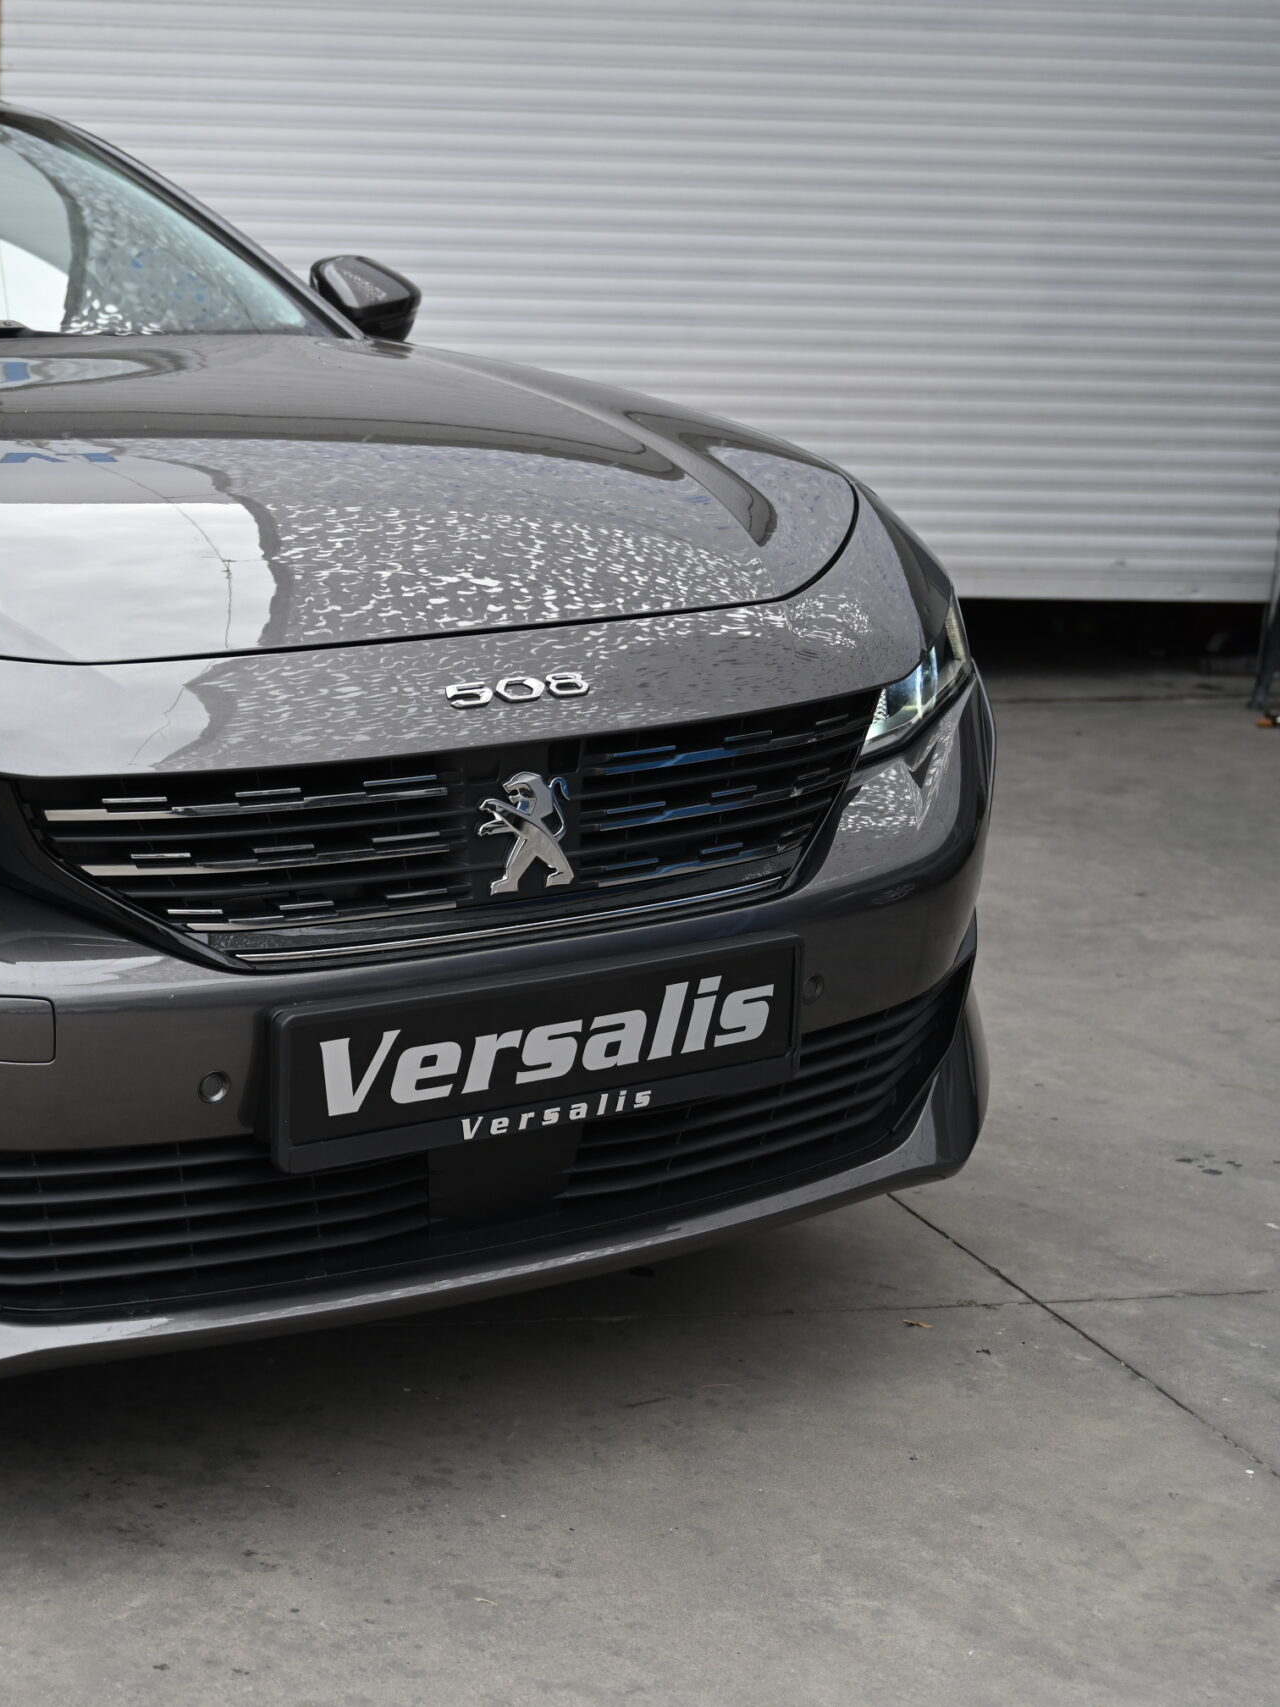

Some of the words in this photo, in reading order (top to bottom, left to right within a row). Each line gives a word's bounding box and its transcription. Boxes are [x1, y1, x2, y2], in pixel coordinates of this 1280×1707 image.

[445, 672, 589, 709] 508
[319, 975, 774, 1117] Versalis
[461, 1089, 652, 1140] Versalis
